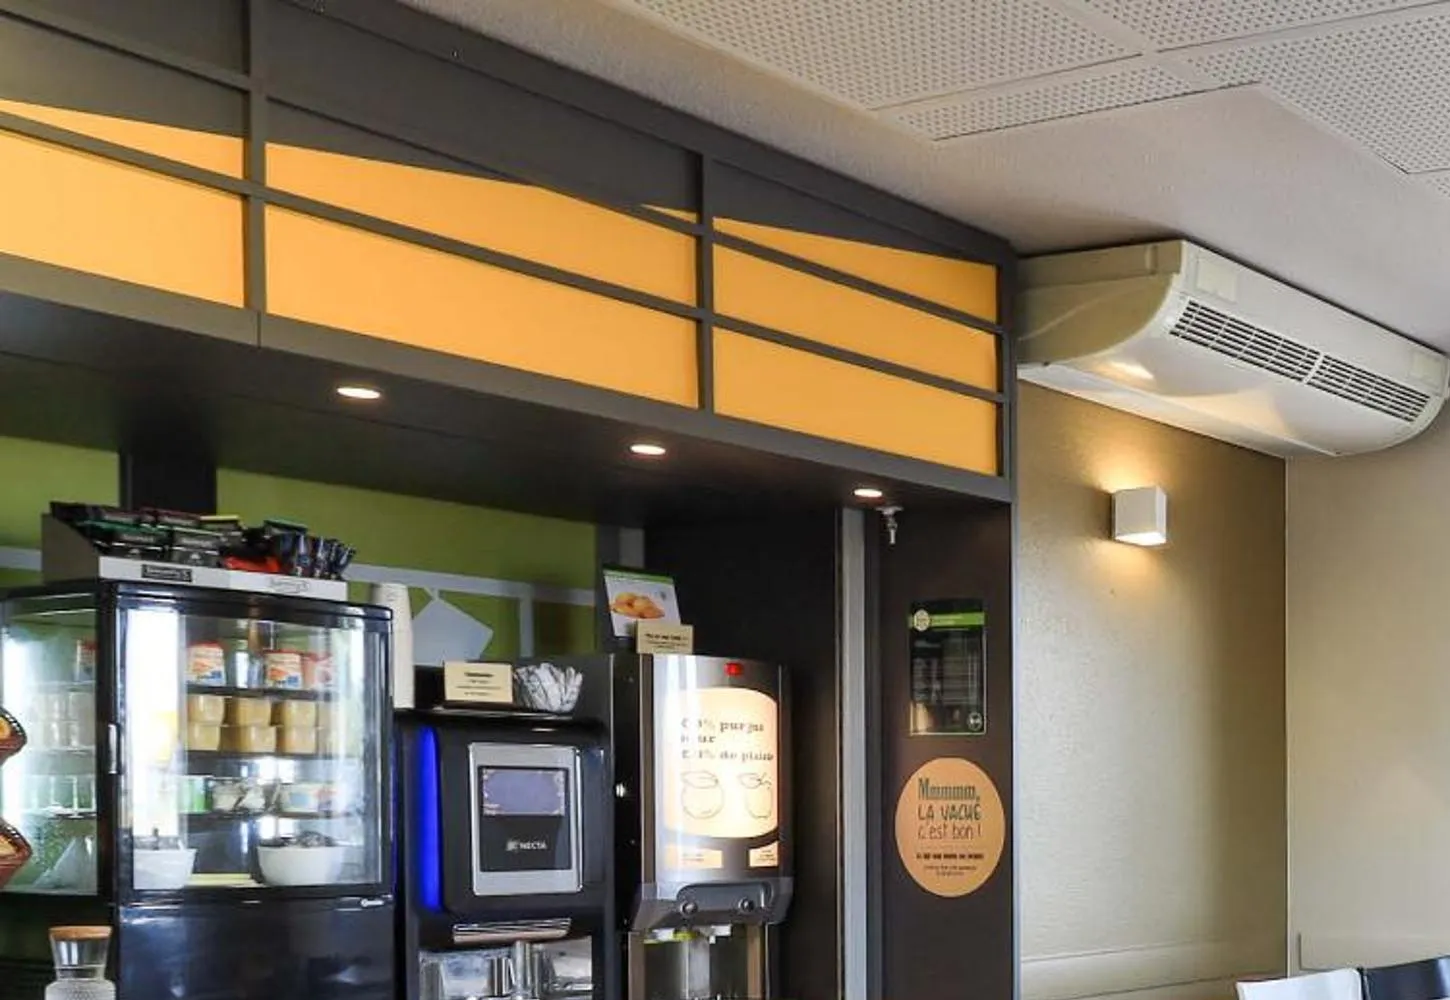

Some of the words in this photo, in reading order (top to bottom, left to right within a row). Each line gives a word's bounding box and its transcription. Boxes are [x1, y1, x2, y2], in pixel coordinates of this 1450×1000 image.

[918, 804, 935, 820] LA
[940, 803, 982, 821] VACHE
[918, 822, 948, 840] c'est
